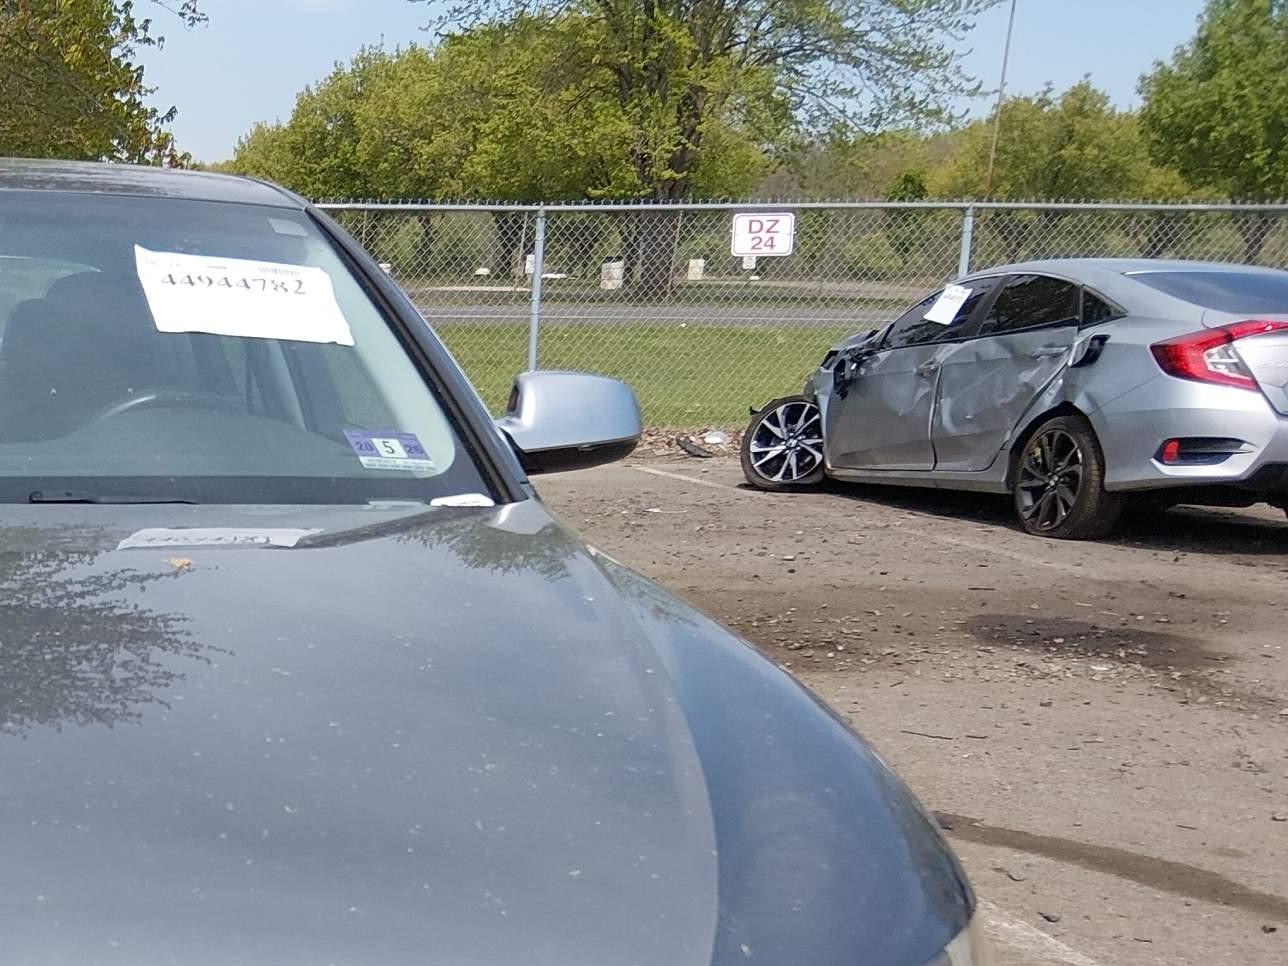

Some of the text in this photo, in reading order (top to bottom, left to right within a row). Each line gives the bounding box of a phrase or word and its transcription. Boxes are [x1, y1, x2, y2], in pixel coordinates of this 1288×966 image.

[748, 219, 780, 234] DZ
[750, 236, 776, 250] 24
[161, 273, 306, 295] 44944782
[381, 440, 395, 454] 5
